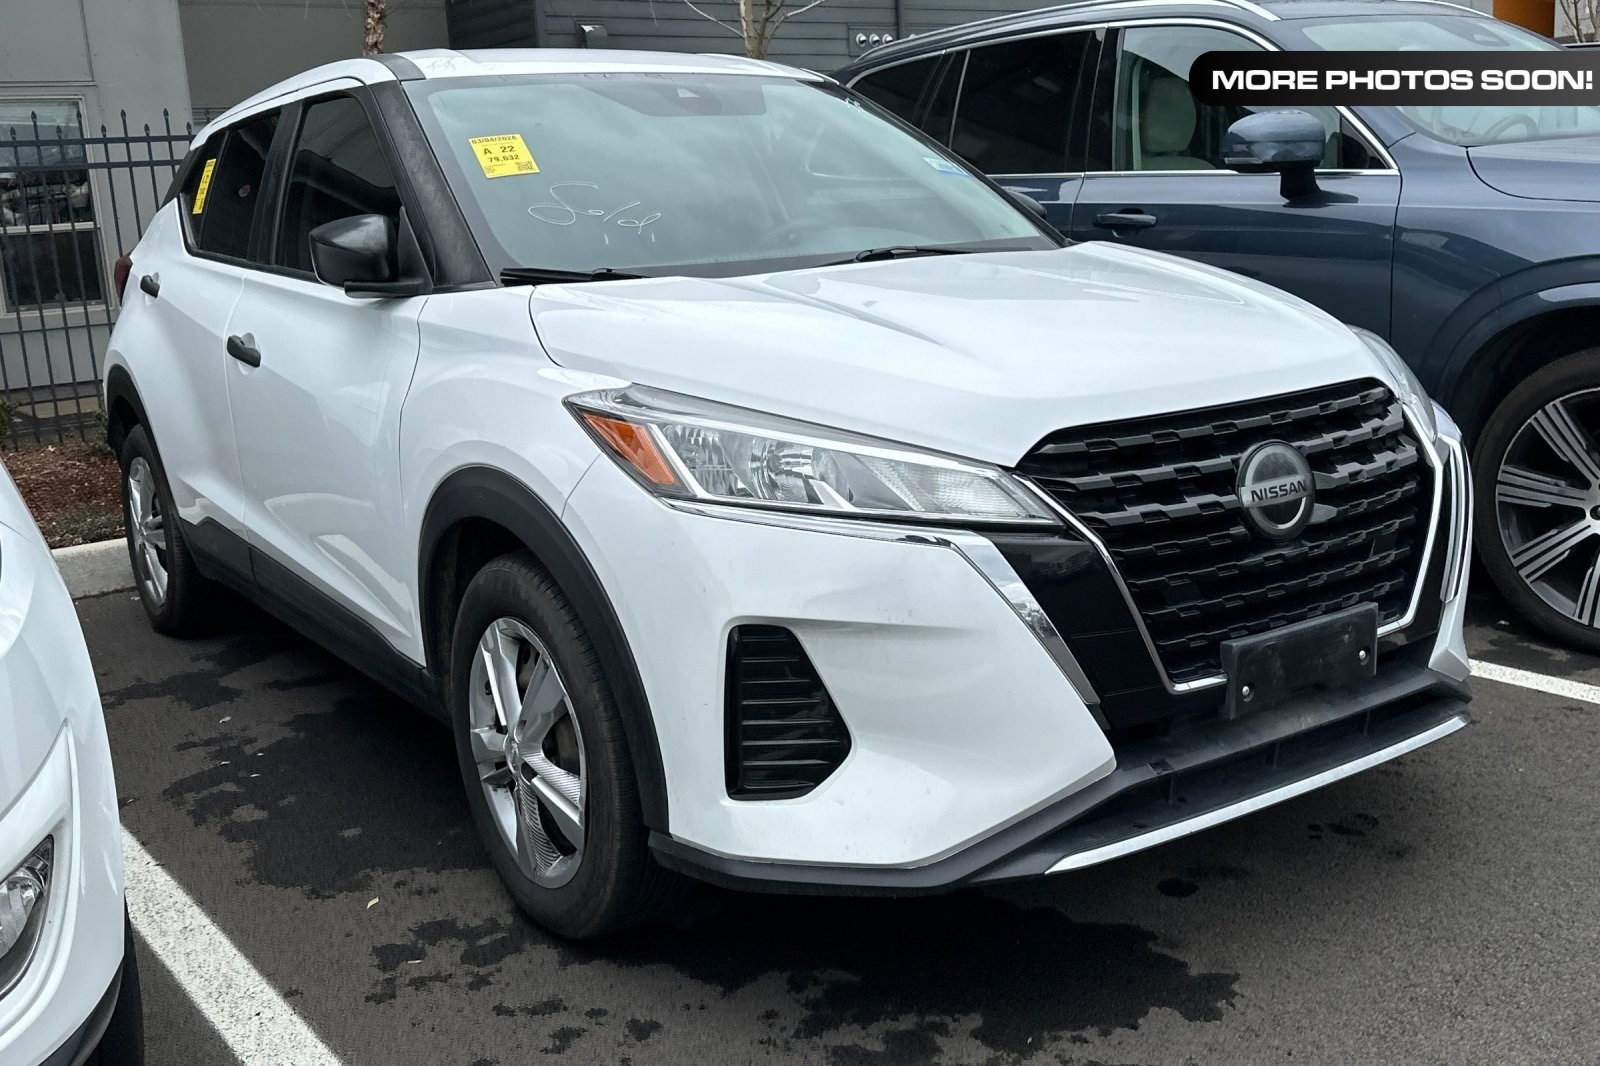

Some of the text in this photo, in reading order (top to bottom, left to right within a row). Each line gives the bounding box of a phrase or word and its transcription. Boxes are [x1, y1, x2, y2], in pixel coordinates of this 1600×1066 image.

[483, 145, 516, 155] A 22
[1250, 480, 1307, 502] NISSAN
